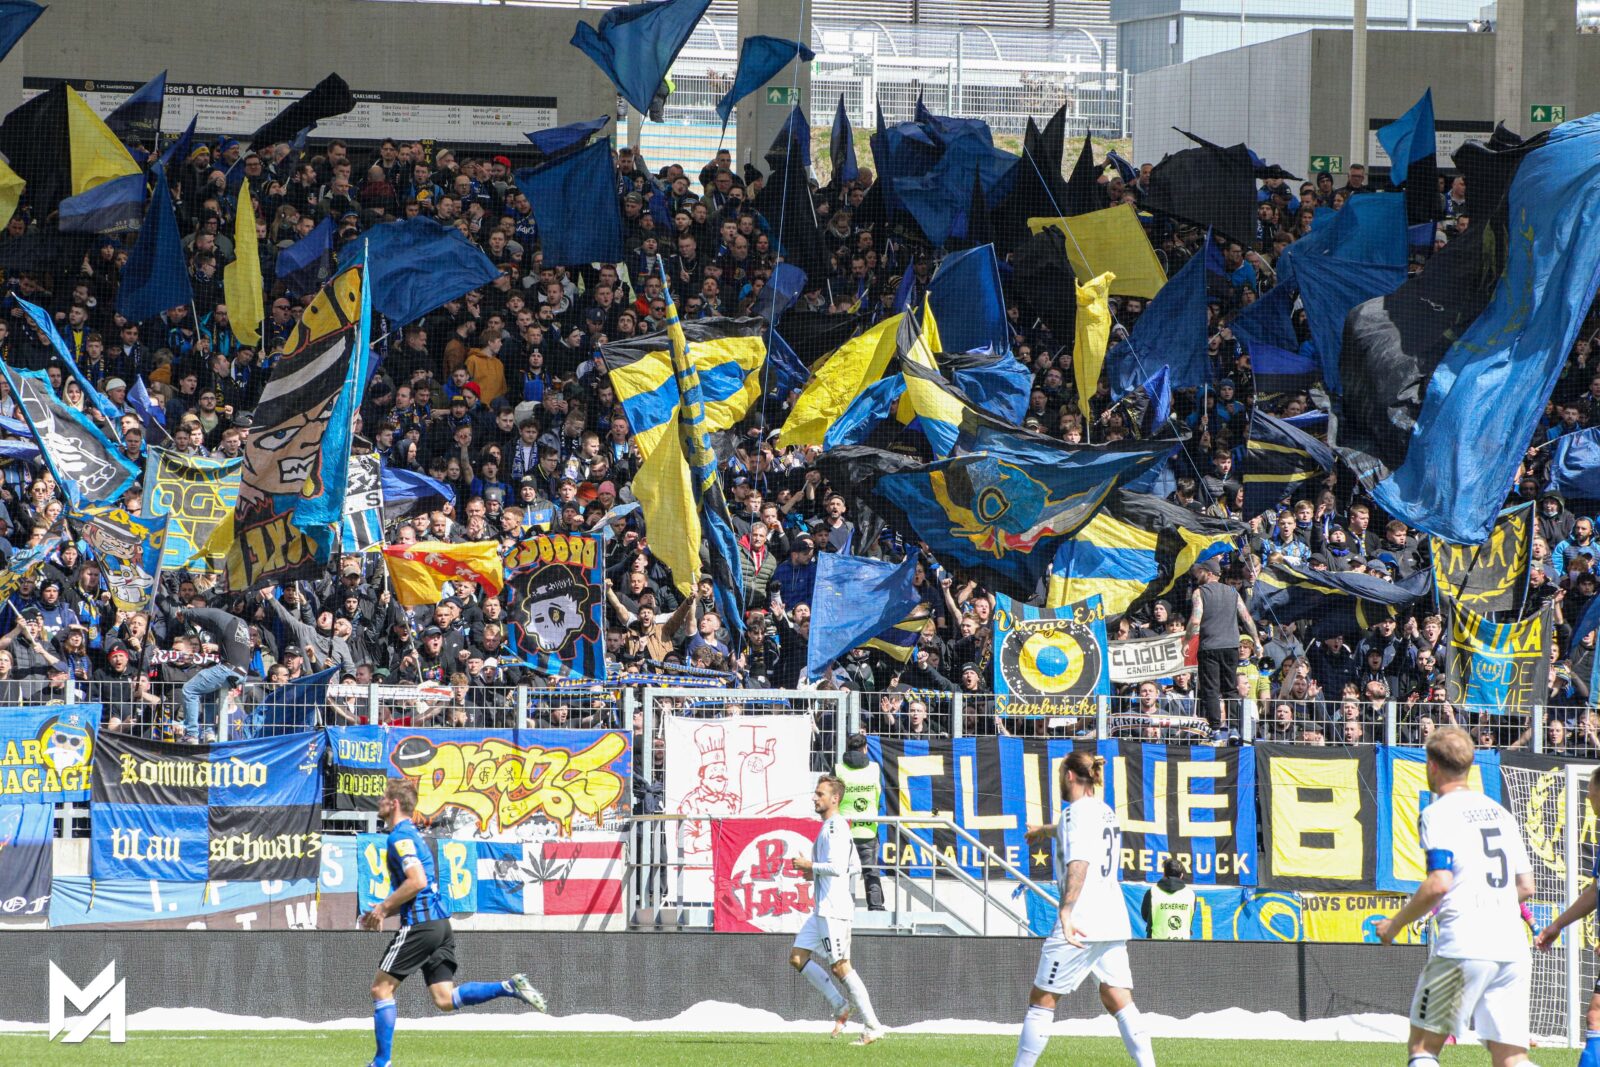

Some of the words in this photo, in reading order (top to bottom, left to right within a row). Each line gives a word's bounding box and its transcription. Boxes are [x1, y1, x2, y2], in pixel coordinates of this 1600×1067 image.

[165, 84, 185, 95] isen
[196, 86, 240, 96] Getränke
[1113, 643, 1177, 666] CLIQUE
[1127, 663, 1165, 675] CANAILLE
[0, 739, 44, 766] AR
[208, 831, 323, 865] schwarz
[882, 842, 1021, 867] CANAILLE
[1479, 827, 1508, 888] 5
